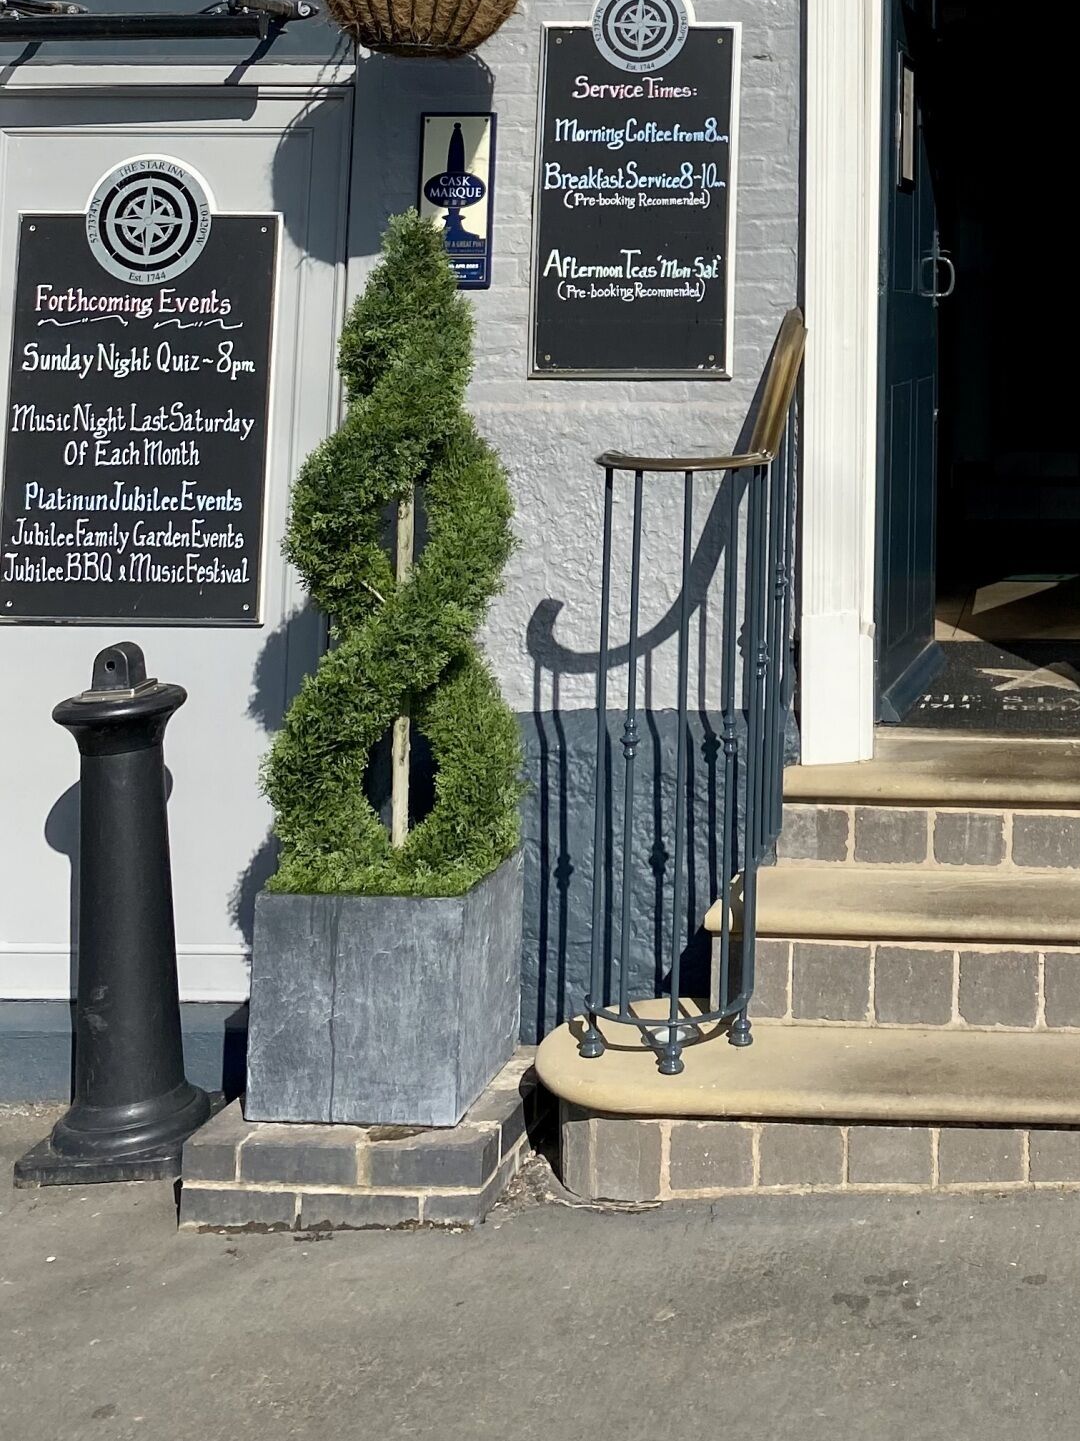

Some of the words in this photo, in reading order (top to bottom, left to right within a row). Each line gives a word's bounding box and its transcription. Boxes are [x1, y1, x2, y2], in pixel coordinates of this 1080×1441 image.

[639, 61, 656, 71] 1744
[572, 75, 644, 99] Service
[642, 76, 698, 99] Times:
[555, 117, 625, 150] Morning
[625, 117, 674, 143] Coffee
[673, 123, 705, 142] from
[118, 162, 139, 178] THE
[139, 160, 166, 170] STAR
[167, 162, 186, 179] INN
[439, 175, 471, 187] CASK
[543, 162, 624, 190] Breakfast
[625, 161, 682, 189] Service
[429, 187, 482, 198] MARQUE
[563, 190, 636, 209] (Pre-booking
[638, 188, 711, 209] Recommended)
[128, 271, 144, 283] Est.
[146, 270, 167, 283] 1744
[543, 248, 623, 279] Afternoon
[620, 248, 657, 279] Teas
[35, 284, 153, 318] Forthcoming
[158, 288, 232, 315] Events
[557, 280, 635, 302] (Pre-booking
[634, 278, 706, 302] Recommended)
[22, 342, 94, 379] Sunday
[97, 343, 151, 378] Night
[156, 341, 200, 373] Quiz
[11, 403, 71, 432] Music
[72, 402, 126, 439] Night
[129, 403, 169, 432] Last
[168, 401, 254, 441] Saturday
[64, 440, 88, 466] Of
[95, 439, 140, 466] Each
[143, 437, 200, 466] Month
[109, 480, 179, 511] Jubilee
[180, 480, 243, 512] Events
[11, 517, 74, 548] Jubilee
[76, 518, 130, 554] Family
[133, 520, 192, 548] Garden
[191, 519, 245, 549] Events
[4, 552, 64, 583] Jubilee
[65, 551, 112, 582] BBQ
[129, 552, 185, 583] Music
[186, 553, 250, 583] Festival
